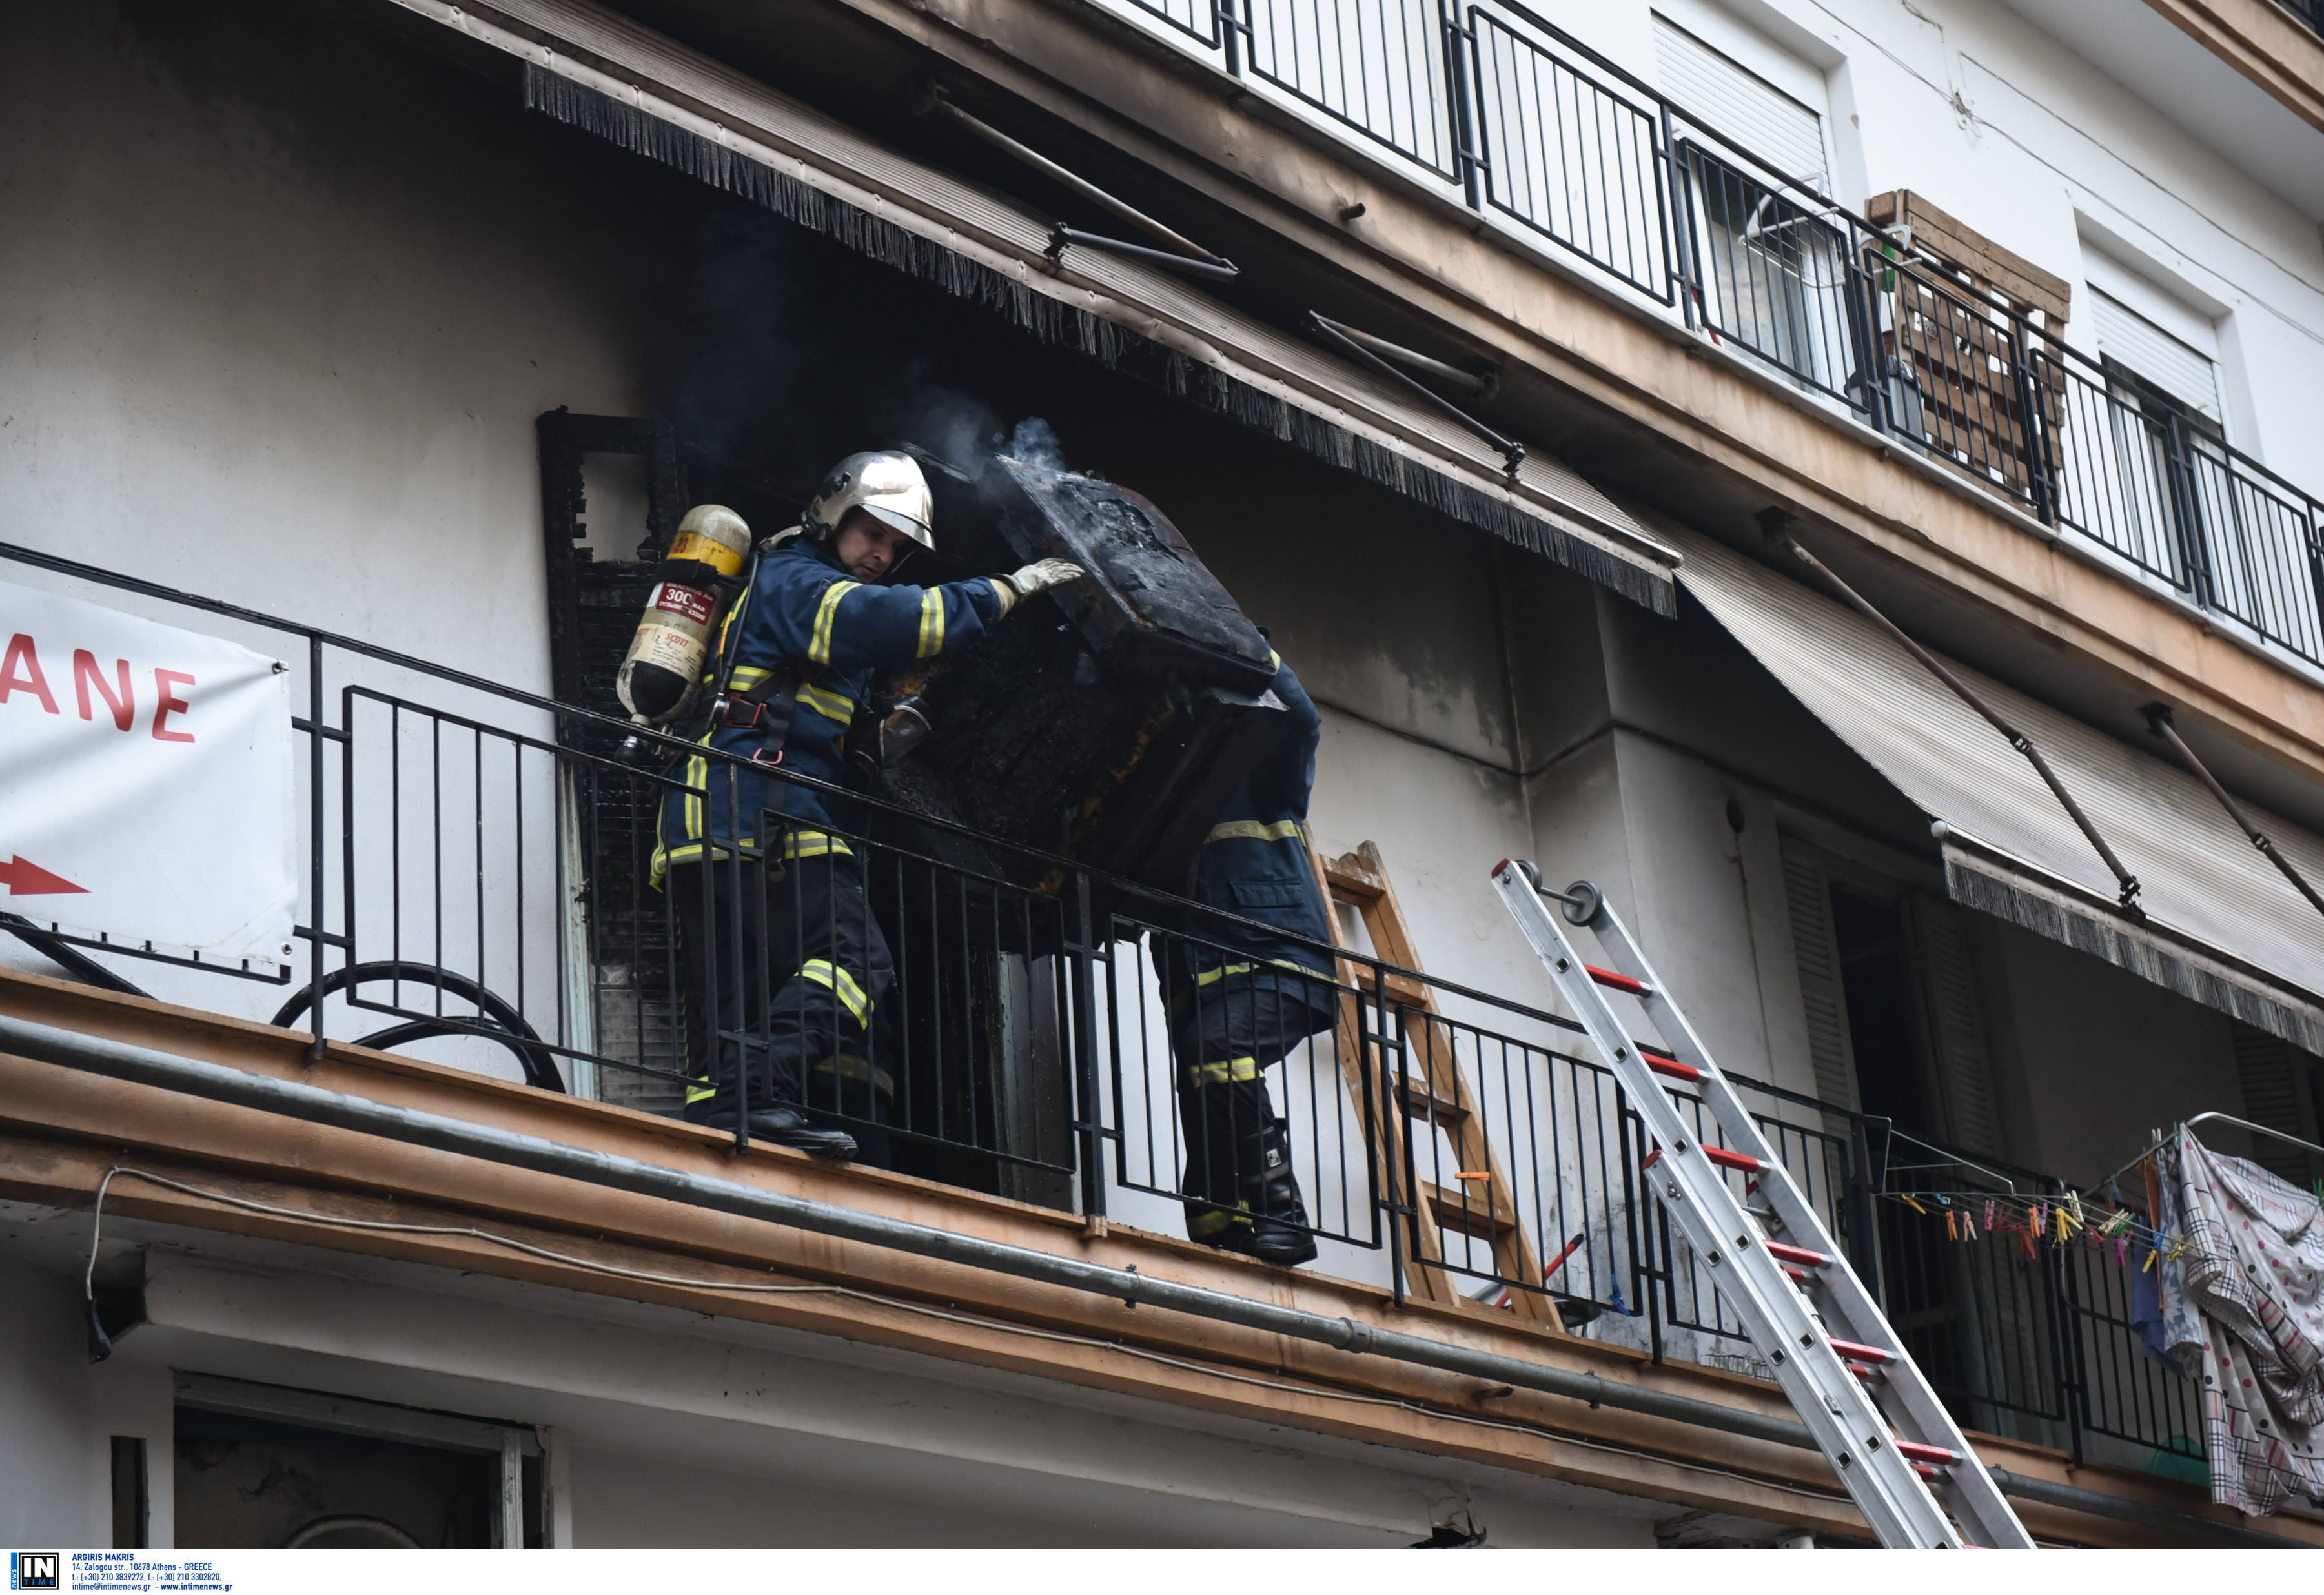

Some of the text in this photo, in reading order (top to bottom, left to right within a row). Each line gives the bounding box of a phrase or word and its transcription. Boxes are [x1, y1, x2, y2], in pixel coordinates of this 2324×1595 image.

[666, 588, 693, 605] 300
[702, 593, 714, 602] AIR
[684, 607, 706, 622] ESSURE
[692, 602, 706, 613] BAR
[665, 633, 689, 647] SCOTT
[0, 633, 196, 743] ANE
